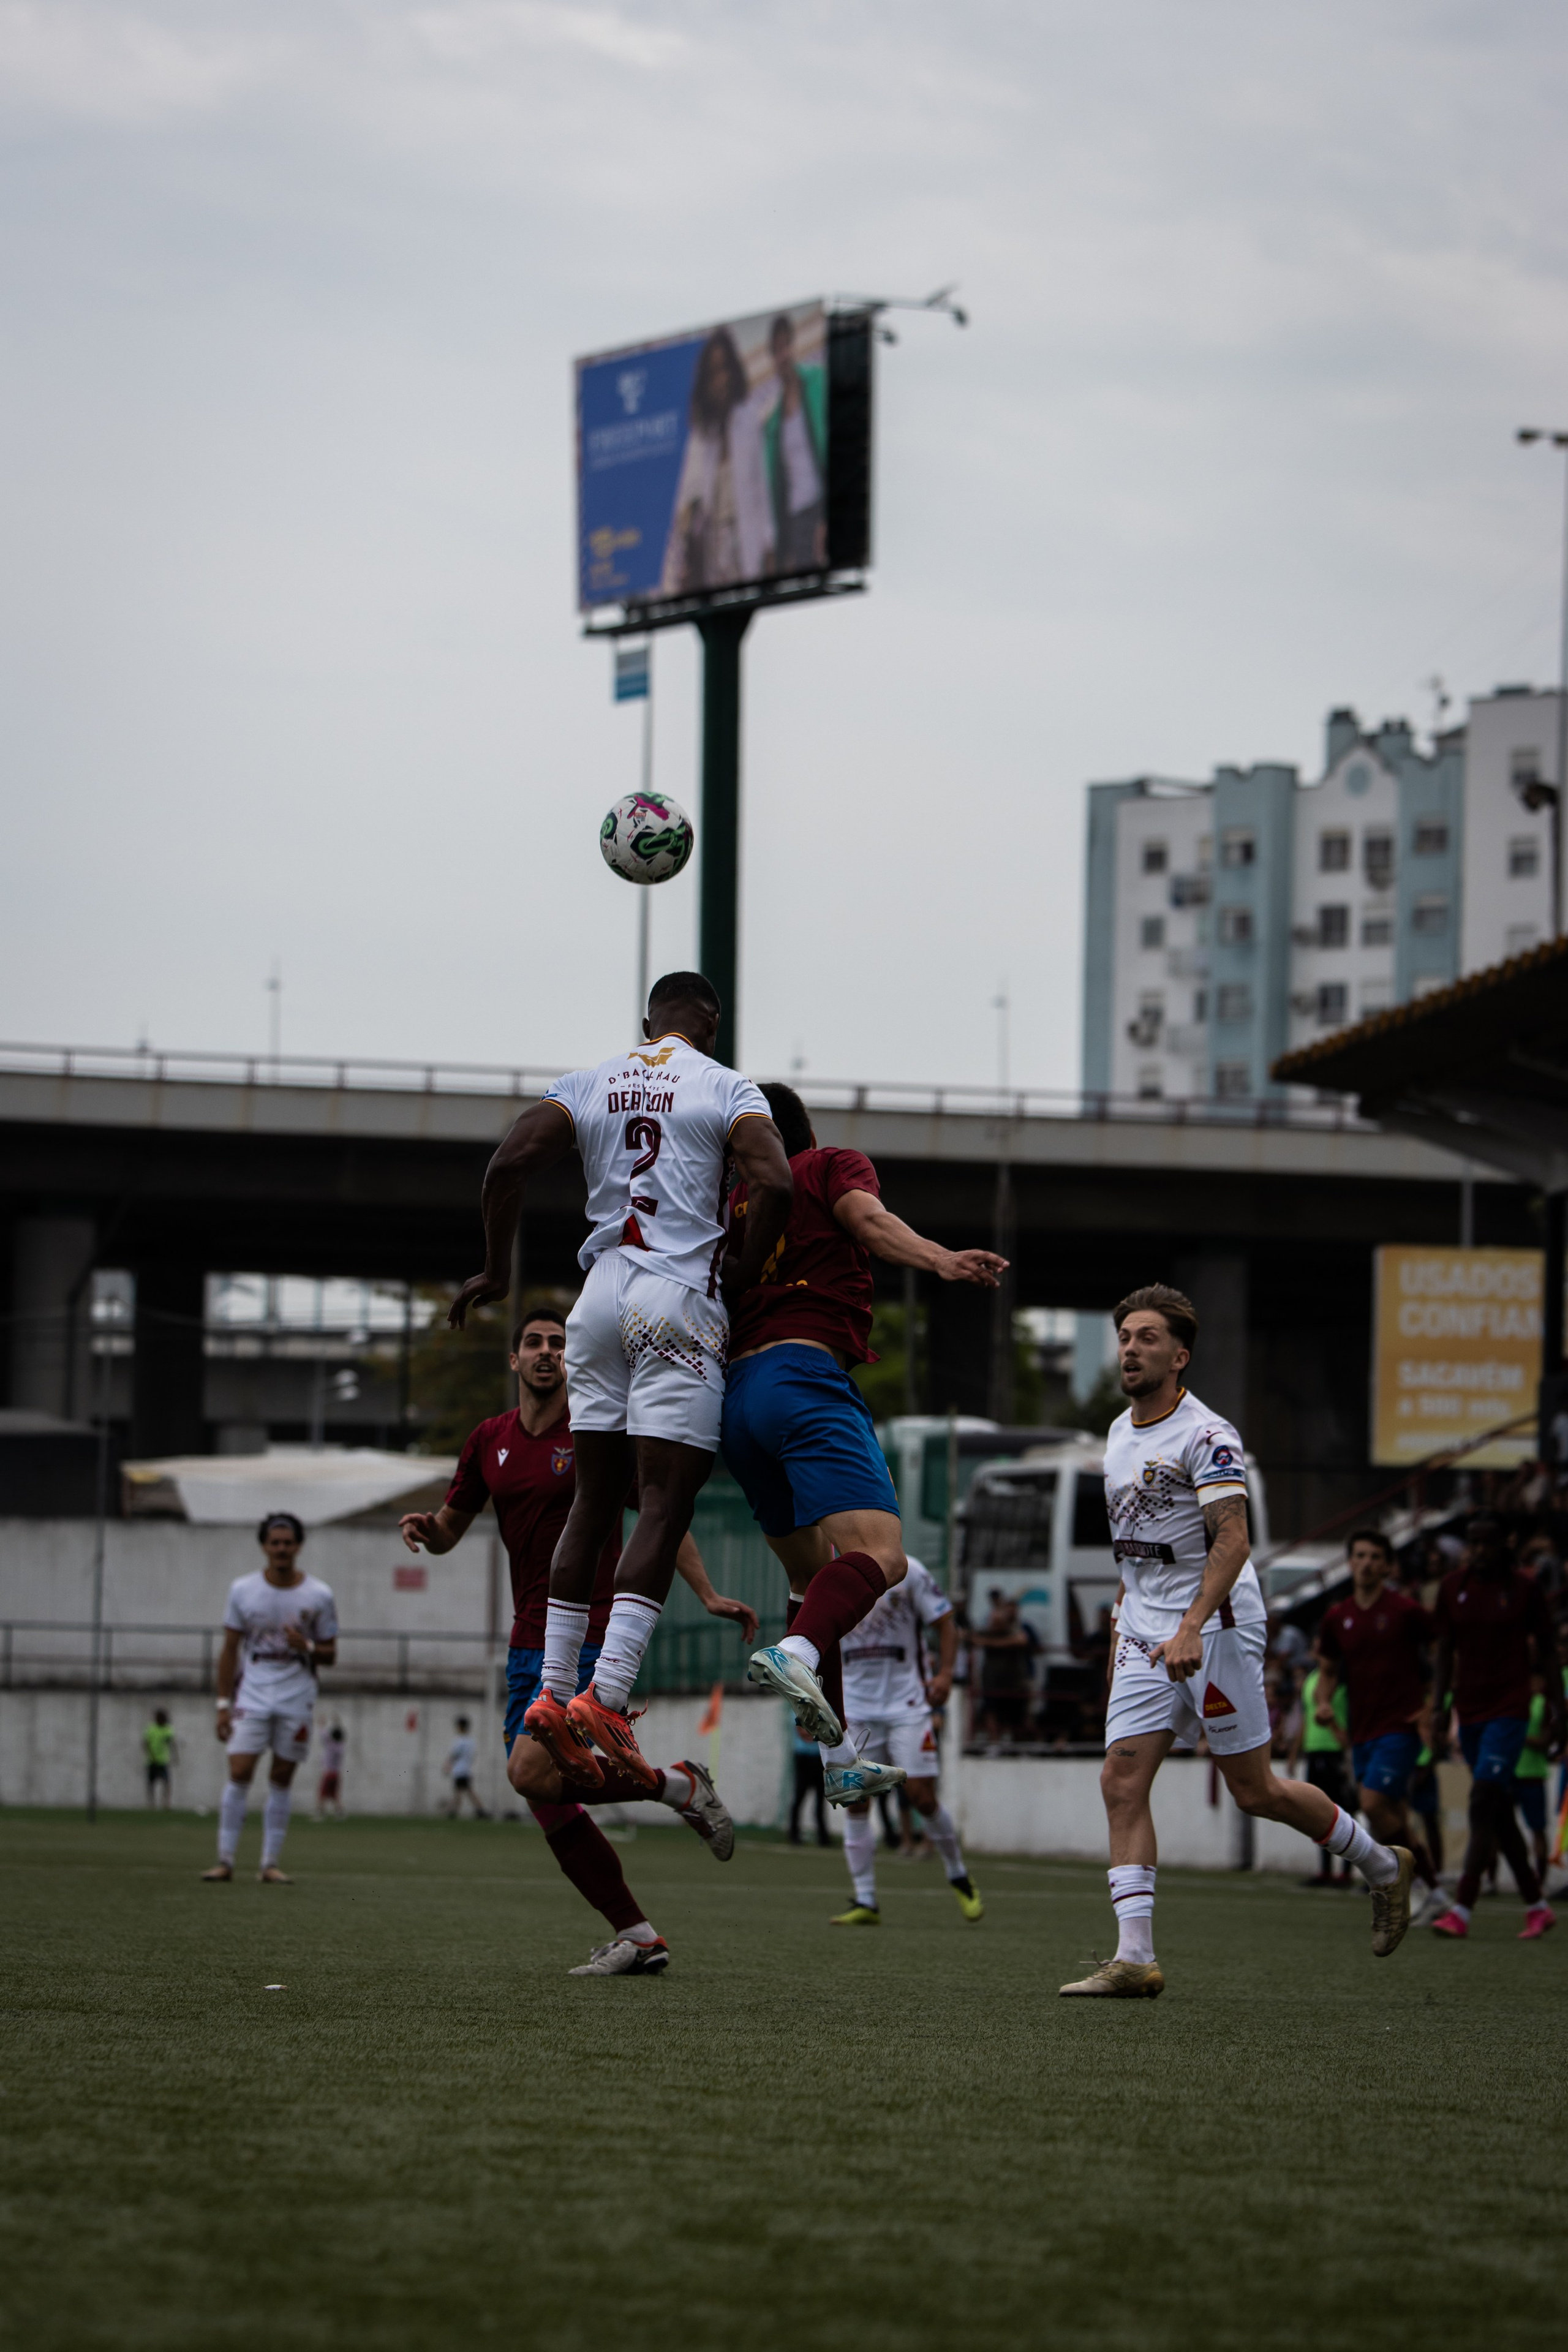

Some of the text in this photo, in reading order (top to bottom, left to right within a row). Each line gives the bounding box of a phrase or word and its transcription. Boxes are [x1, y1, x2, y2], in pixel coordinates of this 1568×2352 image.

[625, 1116, 662, 1217] 2
[1400, 1261, 1540, 1298] USADOS
[1205, 1702, 1227, 1711] DELTA
